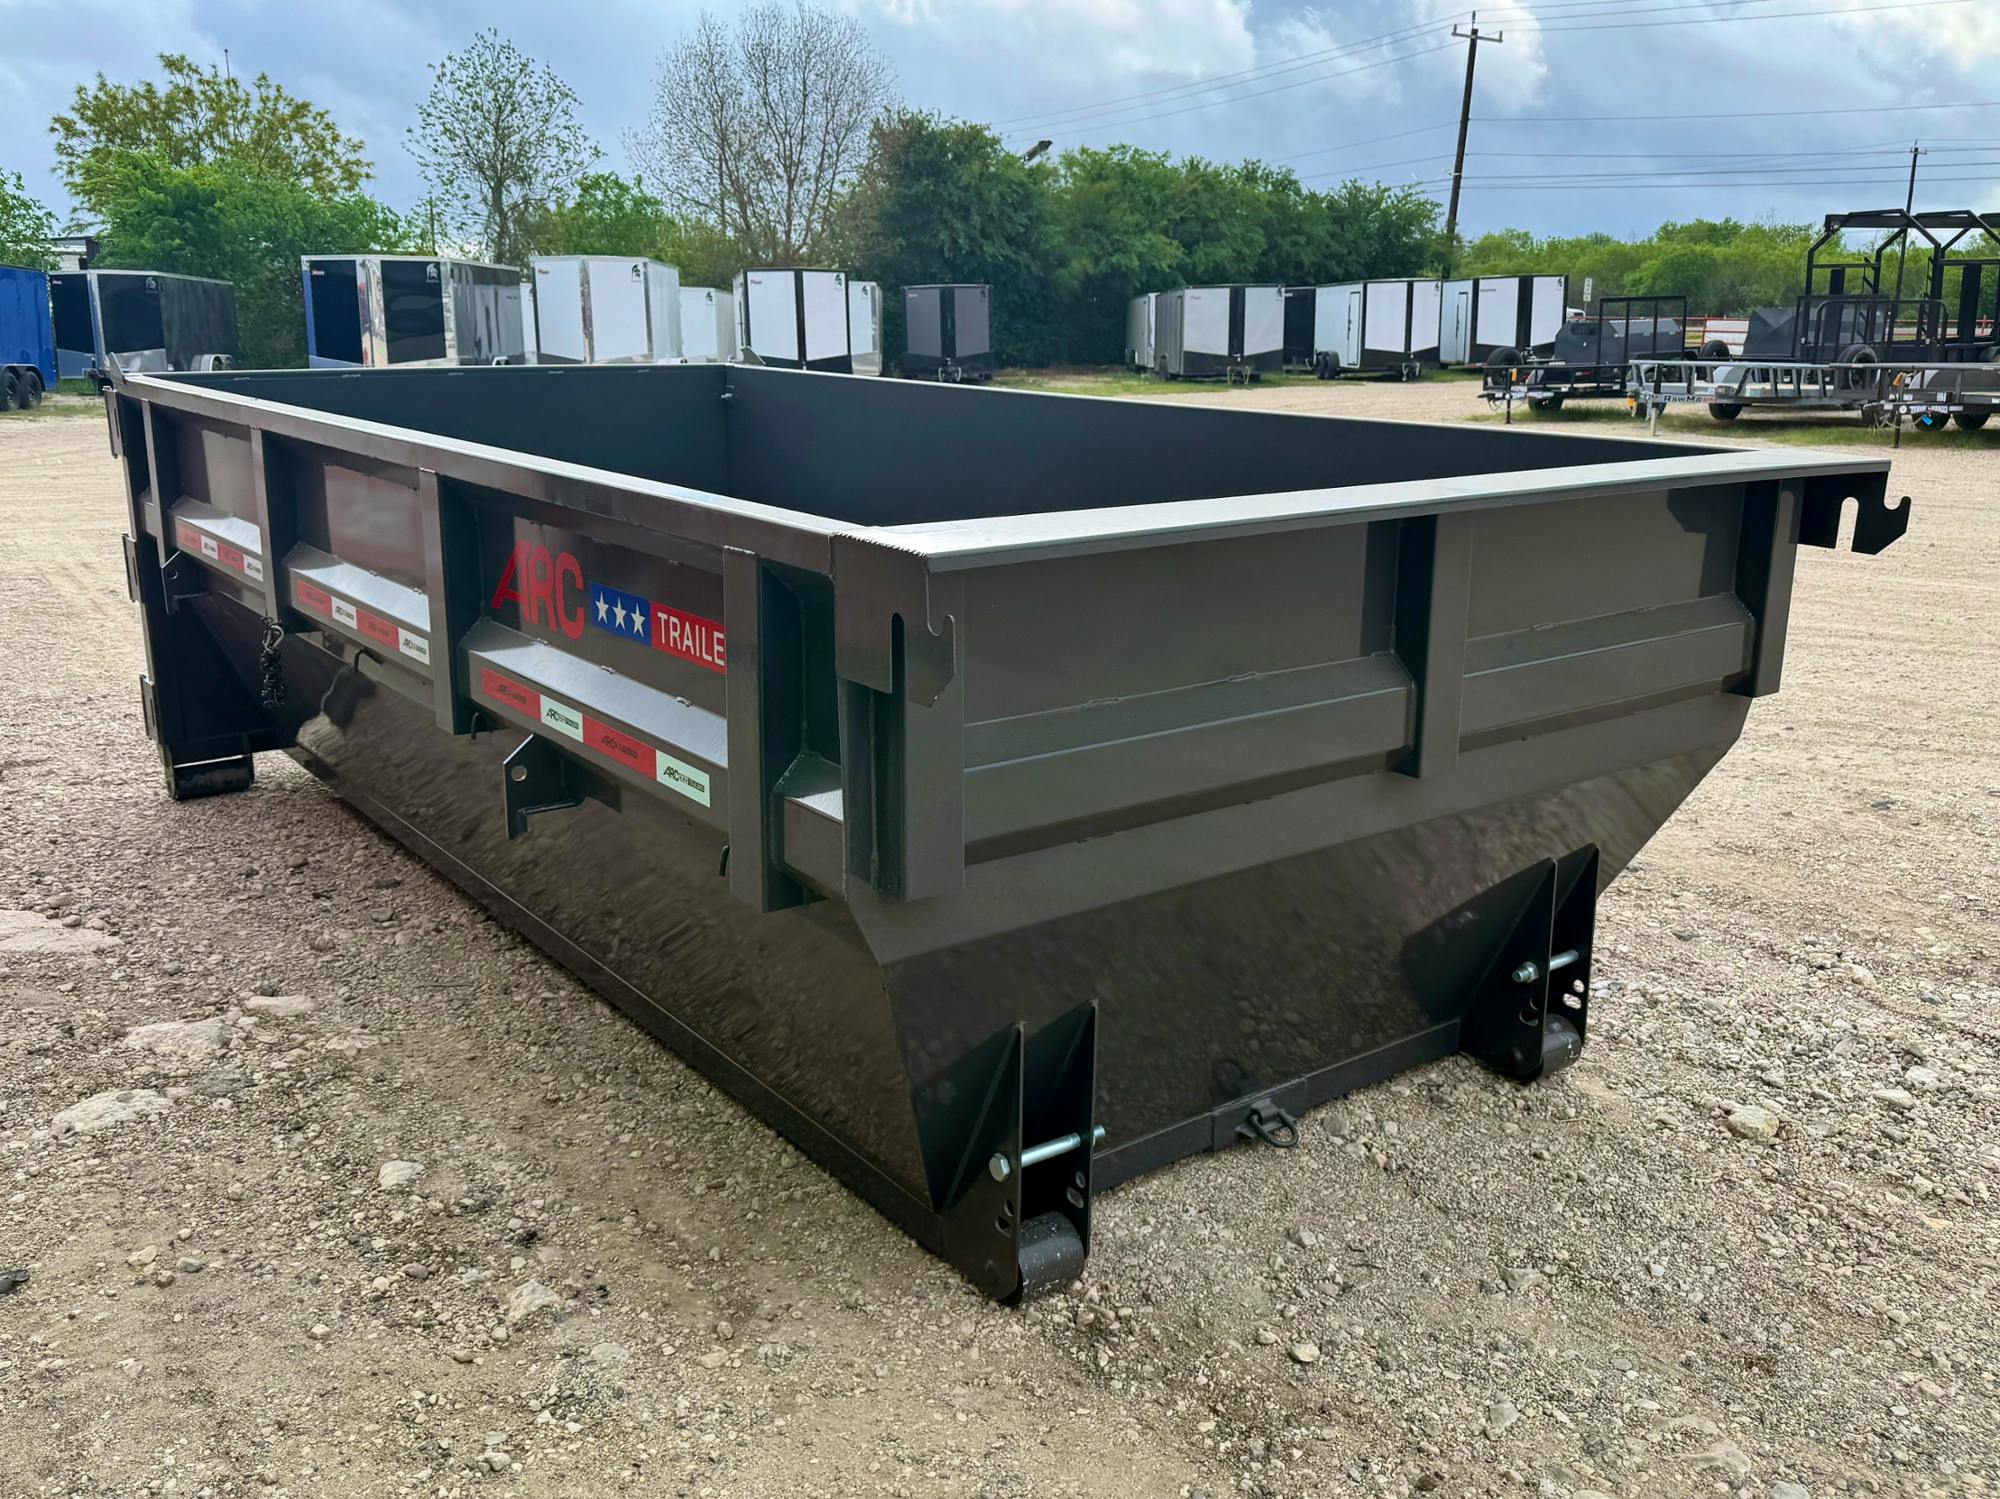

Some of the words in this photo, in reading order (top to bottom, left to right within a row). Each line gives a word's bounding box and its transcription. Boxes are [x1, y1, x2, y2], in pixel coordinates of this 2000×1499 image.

[491, 540, 585, 640] ARC
[657, 611, 725, 665] TRAILE
[663, 765, 680, 782] ARC
